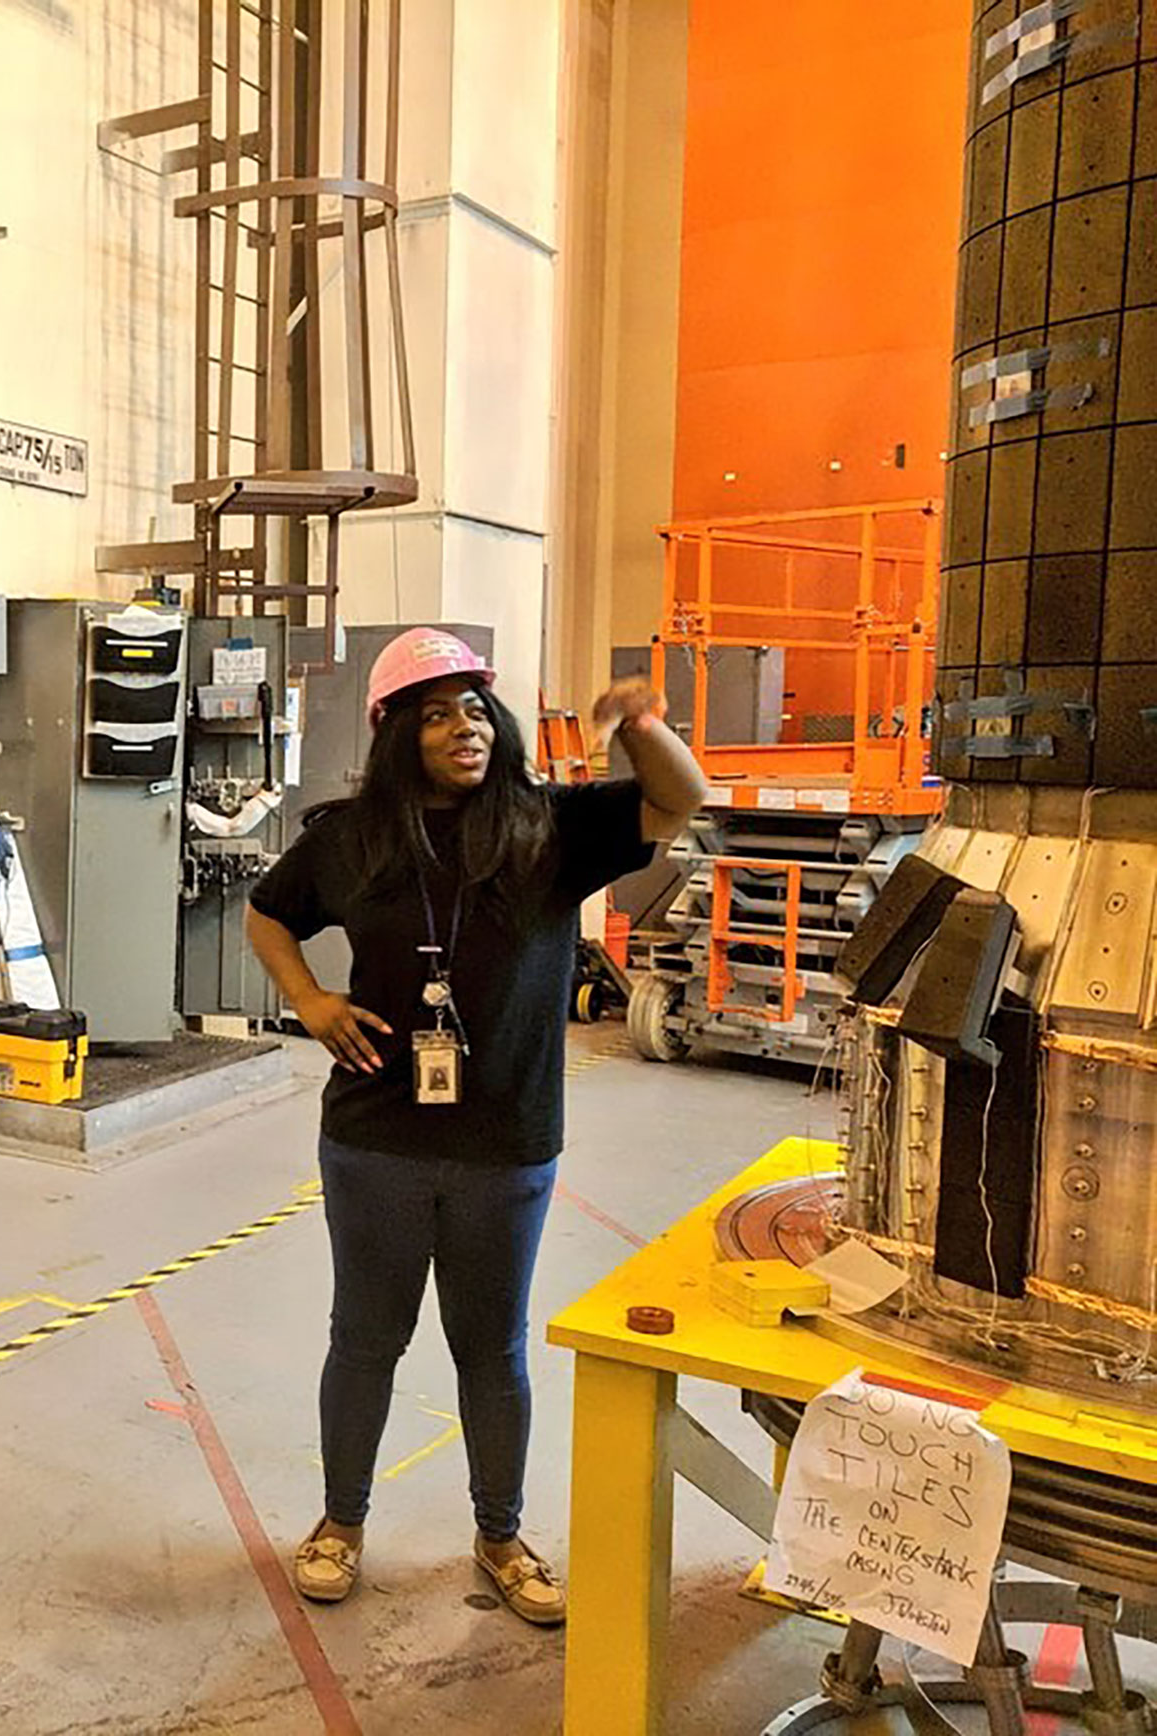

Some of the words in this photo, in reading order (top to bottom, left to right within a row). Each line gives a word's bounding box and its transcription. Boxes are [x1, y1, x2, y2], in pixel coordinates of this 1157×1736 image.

[64, 443, 85, 473] TON
[825, 1406, 974, 1483] TOUCH
[827, 1447, 974, 1530] TILES
[794, 1497, 843, 1537] THE
[868, 1499, 900, 1525] ON
